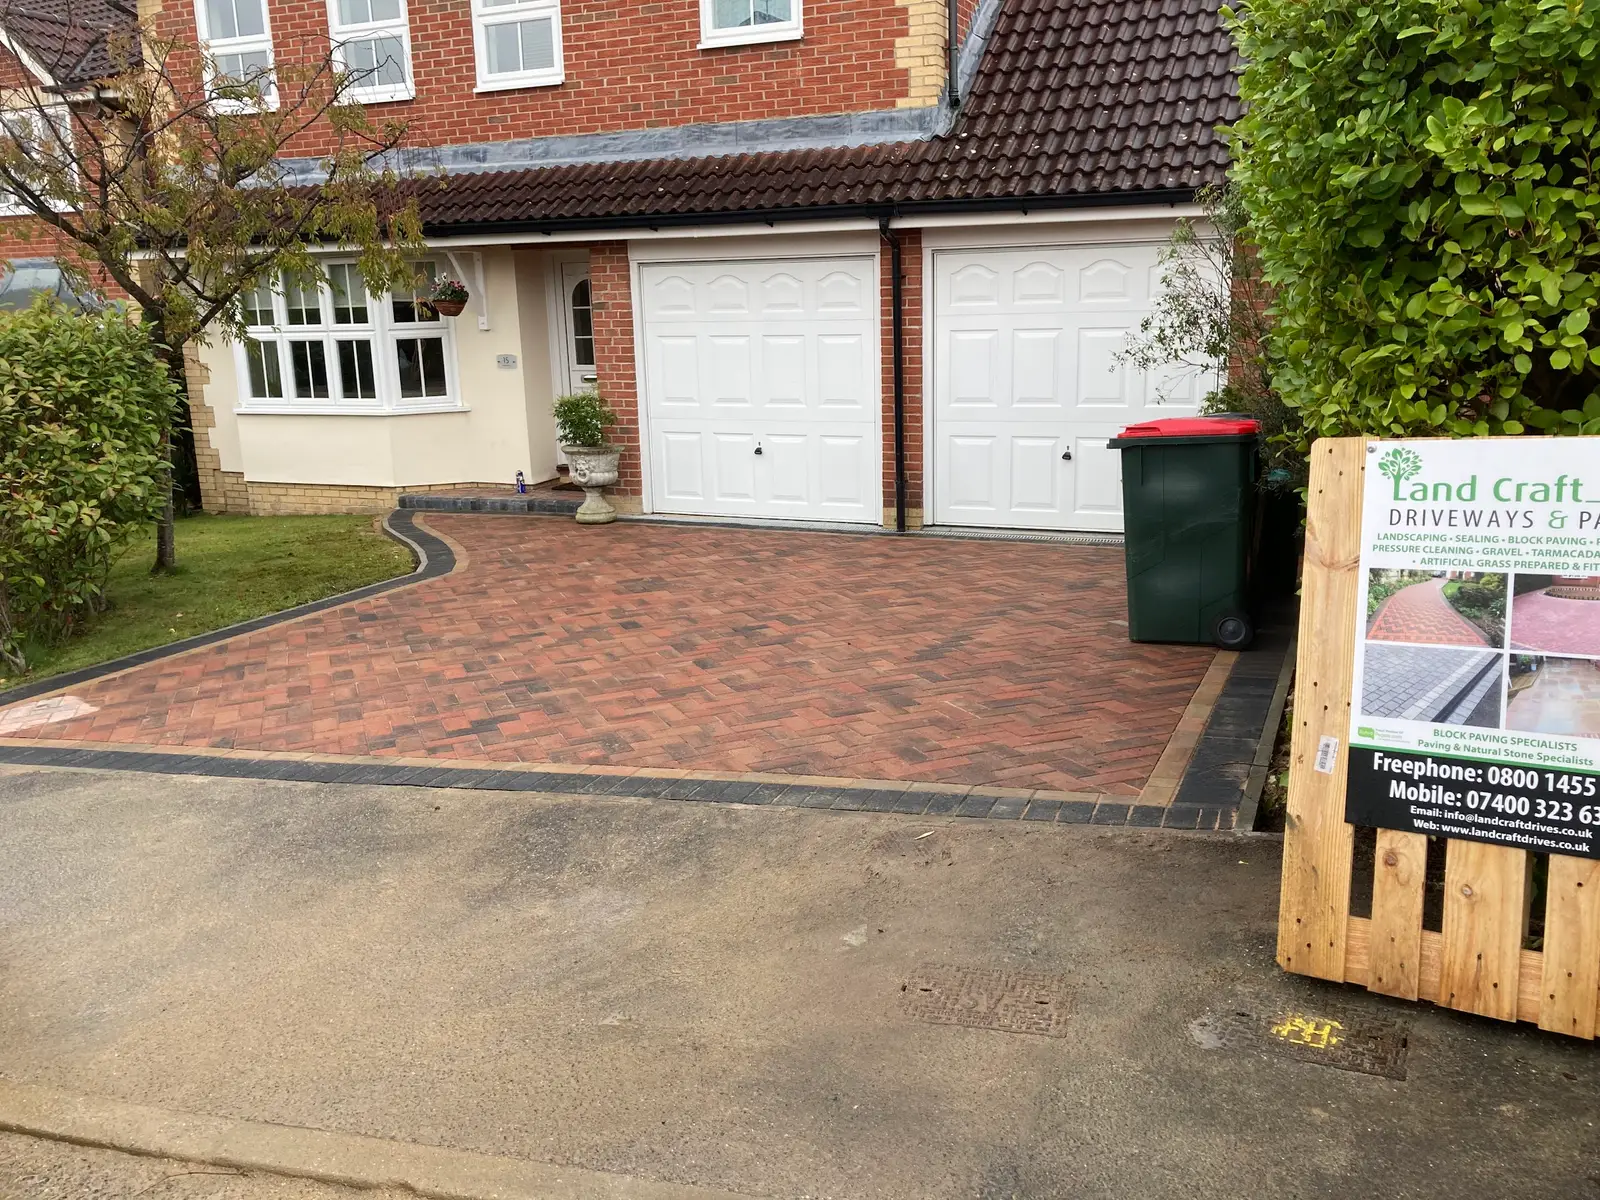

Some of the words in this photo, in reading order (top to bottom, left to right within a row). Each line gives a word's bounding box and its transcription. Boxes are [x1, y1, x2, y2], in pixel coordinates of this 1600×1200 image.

[502, 356, 510, 364] 15
[1393, 475, 1477, 502] Land
[1494, 474, 1583, 502] Craft
[1389, 508, 1534, 529] DRIVEWAYS
[1548, 510, 1568, 529] &
[1372, 544, 1421, 554] PRESSURE
[1422, 545, 1474, 555] CLEANING
[1482, 547, 1523, 557] GRAVEL
[1377, 533, 1447, 543] LANDSCAPING
[1455, 535, 1499, 544] SEALING
[1508, 536, 1544, 545] BLOCK
[1545, 536, 1587, 546] PAVING
[1420, 557, 1474, 567] ARTIFICIAL
[1477, 558, 1511, 568] GRASS
[1513, 560, 1569, 570] PREPARED
[1572, 561, 1581, 570] &
[1583, 562, 1600, 571] FIT
[1417, 739, 1451, 752] Paving
[1453, 743, 1461, 752] &
[1463, 743, 1502, 756] Natural
[1503, 747, 1534, 760] Stone
[1537, 750, 1594, 767] Specialists
[1433, 728, 1467, 740] BLOCK
[1469, 732, 1508, 745] PAVING
[1510, 736, 1577, 752] SPECIALISTS
[1373, 752, 1482, 783] Freephone:
[1488, 766, 1539, 790] 0800
[1544, 772, 1596, 796] 1455
[1389, 780, 1461, 807] Mobile:
[1467, 790, 1530, 815] 07400
[1534, 799, 1573, 822] 323
[1410, 806, 1443, 818] Email:
[1444, 809, 1593, 839] info@landcraftdrives.co.uk
[1413, 818, 1440, 831] Web:
[1441, 824, 1590, 852] www.landcraftdrives.co.uk
